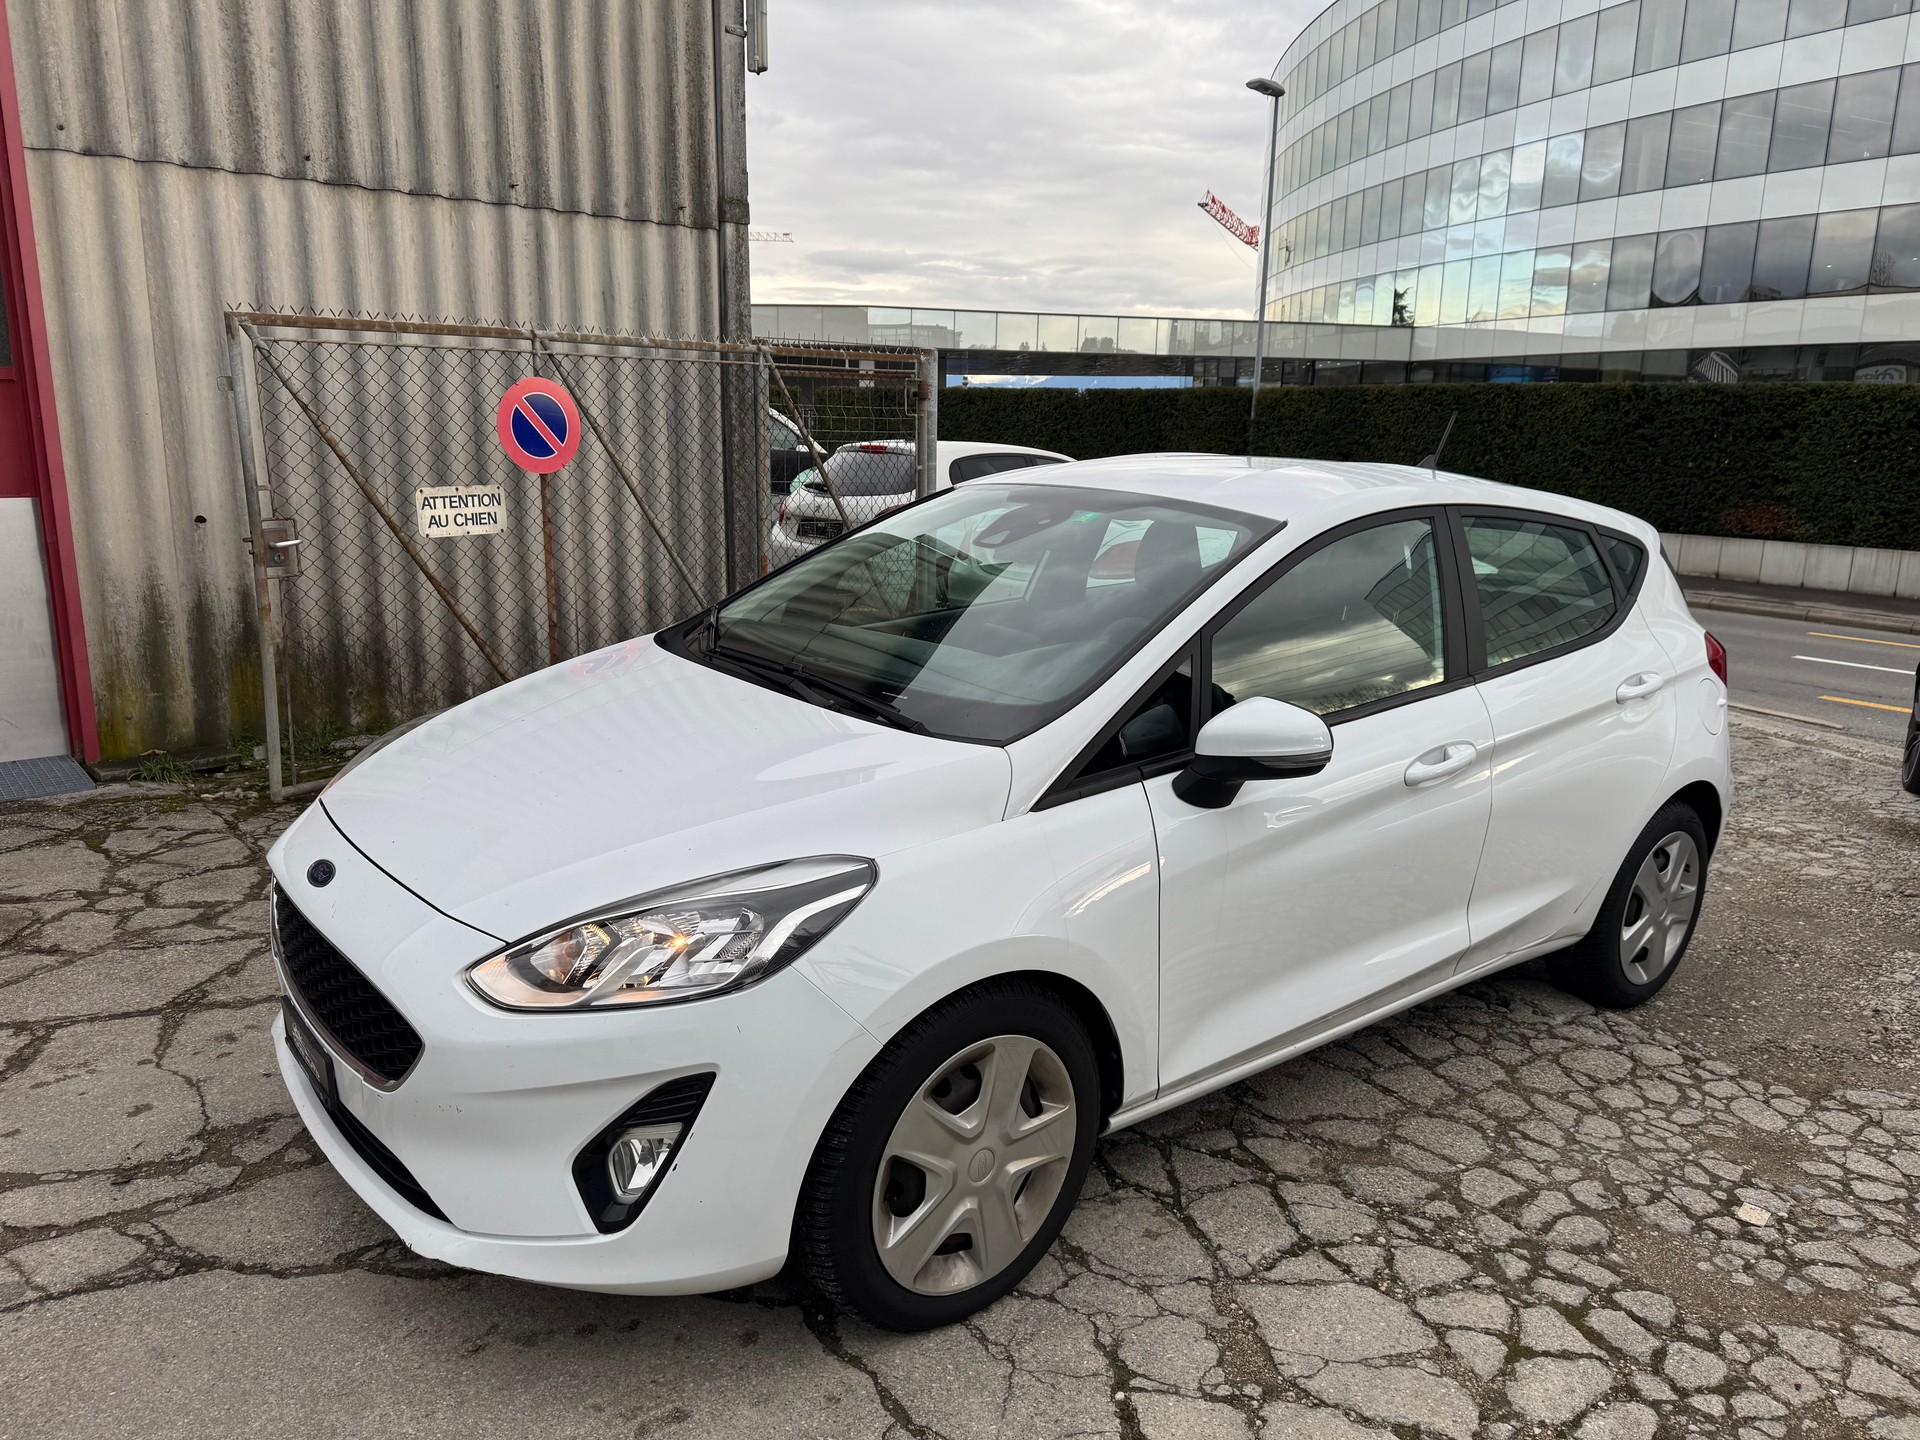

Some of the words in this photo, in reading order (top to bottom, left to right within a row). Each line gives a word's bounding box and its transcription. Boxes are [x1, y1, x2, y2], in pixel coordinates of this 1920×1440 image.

[421, 493, 501, 510] ATTENTION
[428, 514, 448, 528] AU
[454, 511, 497, 526] CHIEN
